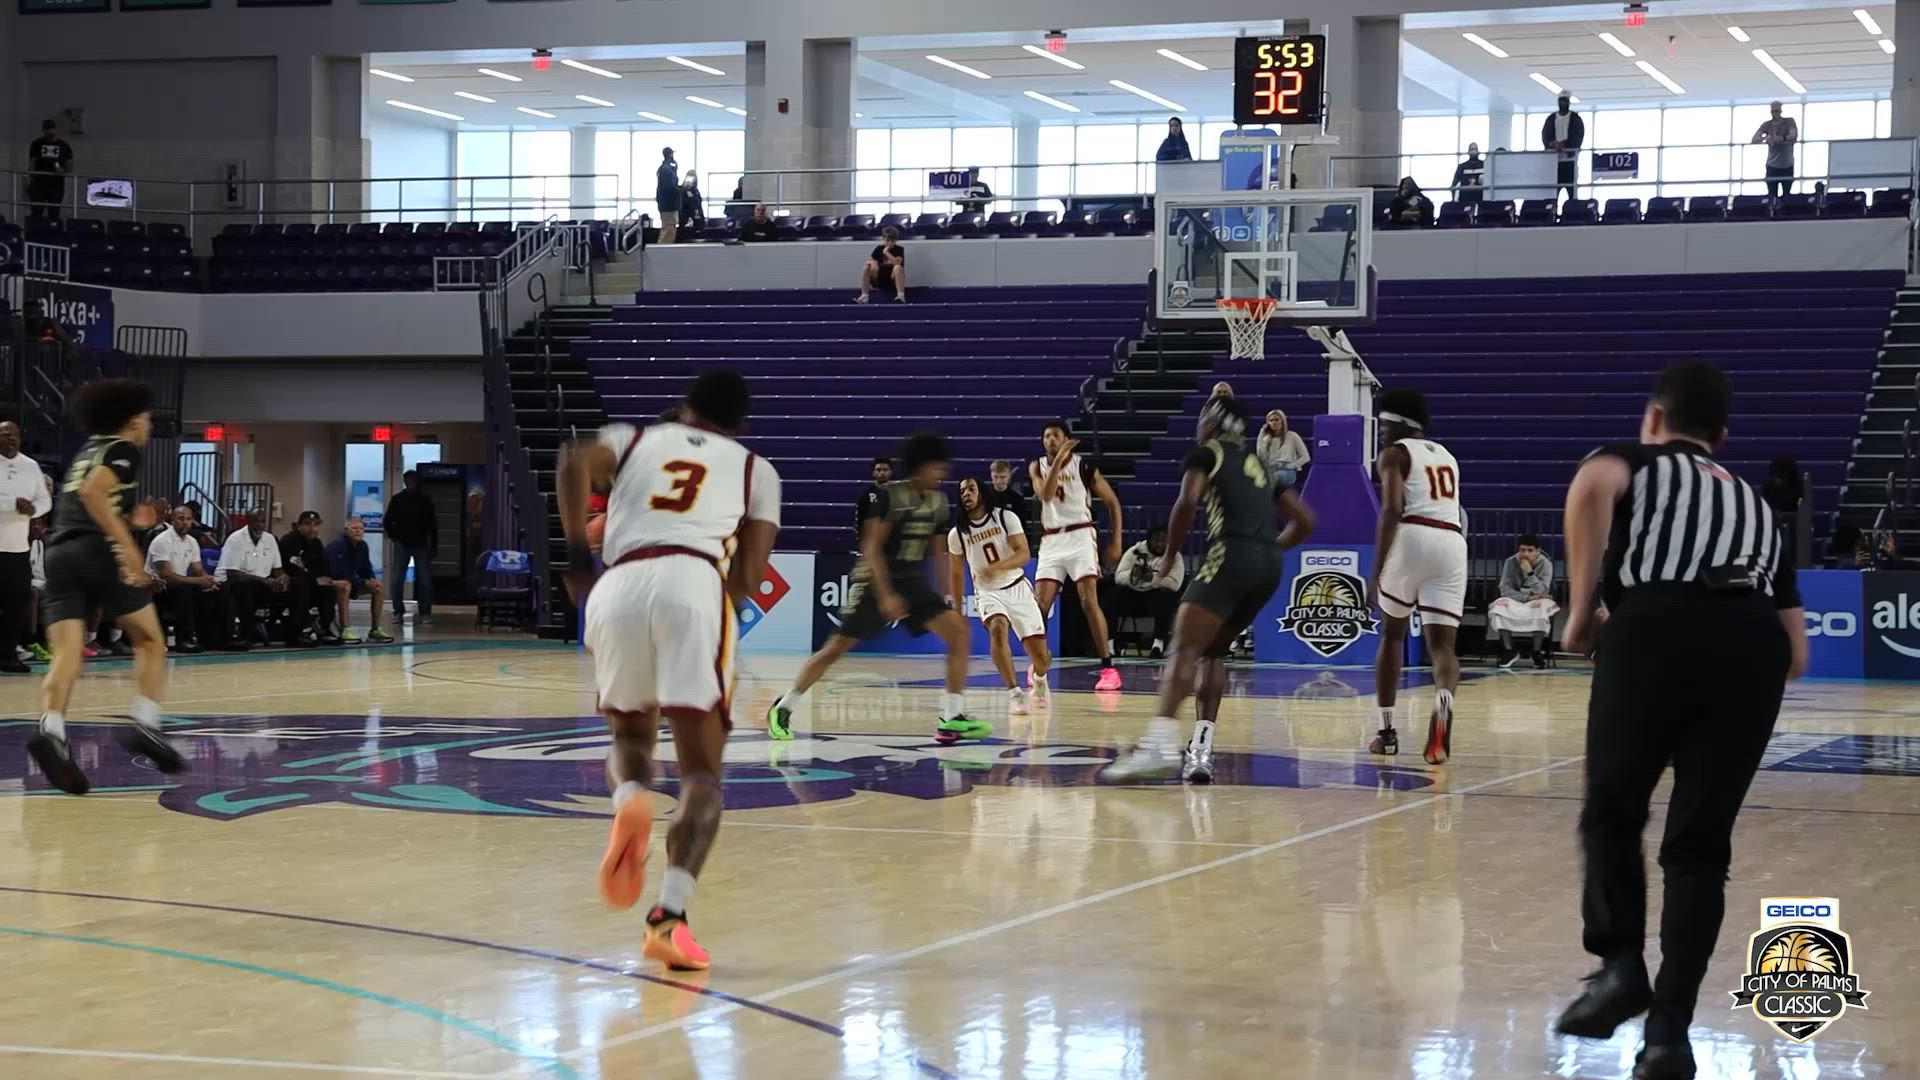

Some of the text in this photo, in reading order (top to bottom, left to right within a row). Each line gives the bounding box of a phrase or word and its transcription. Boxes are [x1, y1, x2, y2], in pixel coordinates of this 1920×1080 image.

[1258, 43, 1314, 68] 5:53
[1254, 71, 1302, 115] 32
[1609, 155, 1632, 167] 102
[944, 174, 962, 185] 101
[649, 459, 708, 514] 3
[1424, 465, 1456, 501] 10
[982, 542, 1000, 564] 0
[1306, 556, 1352, 566] GEICO
[1290, 606, 1366, 621] CITY OF PALMS
[1302, 621, 1351, 637] CLASSIC
